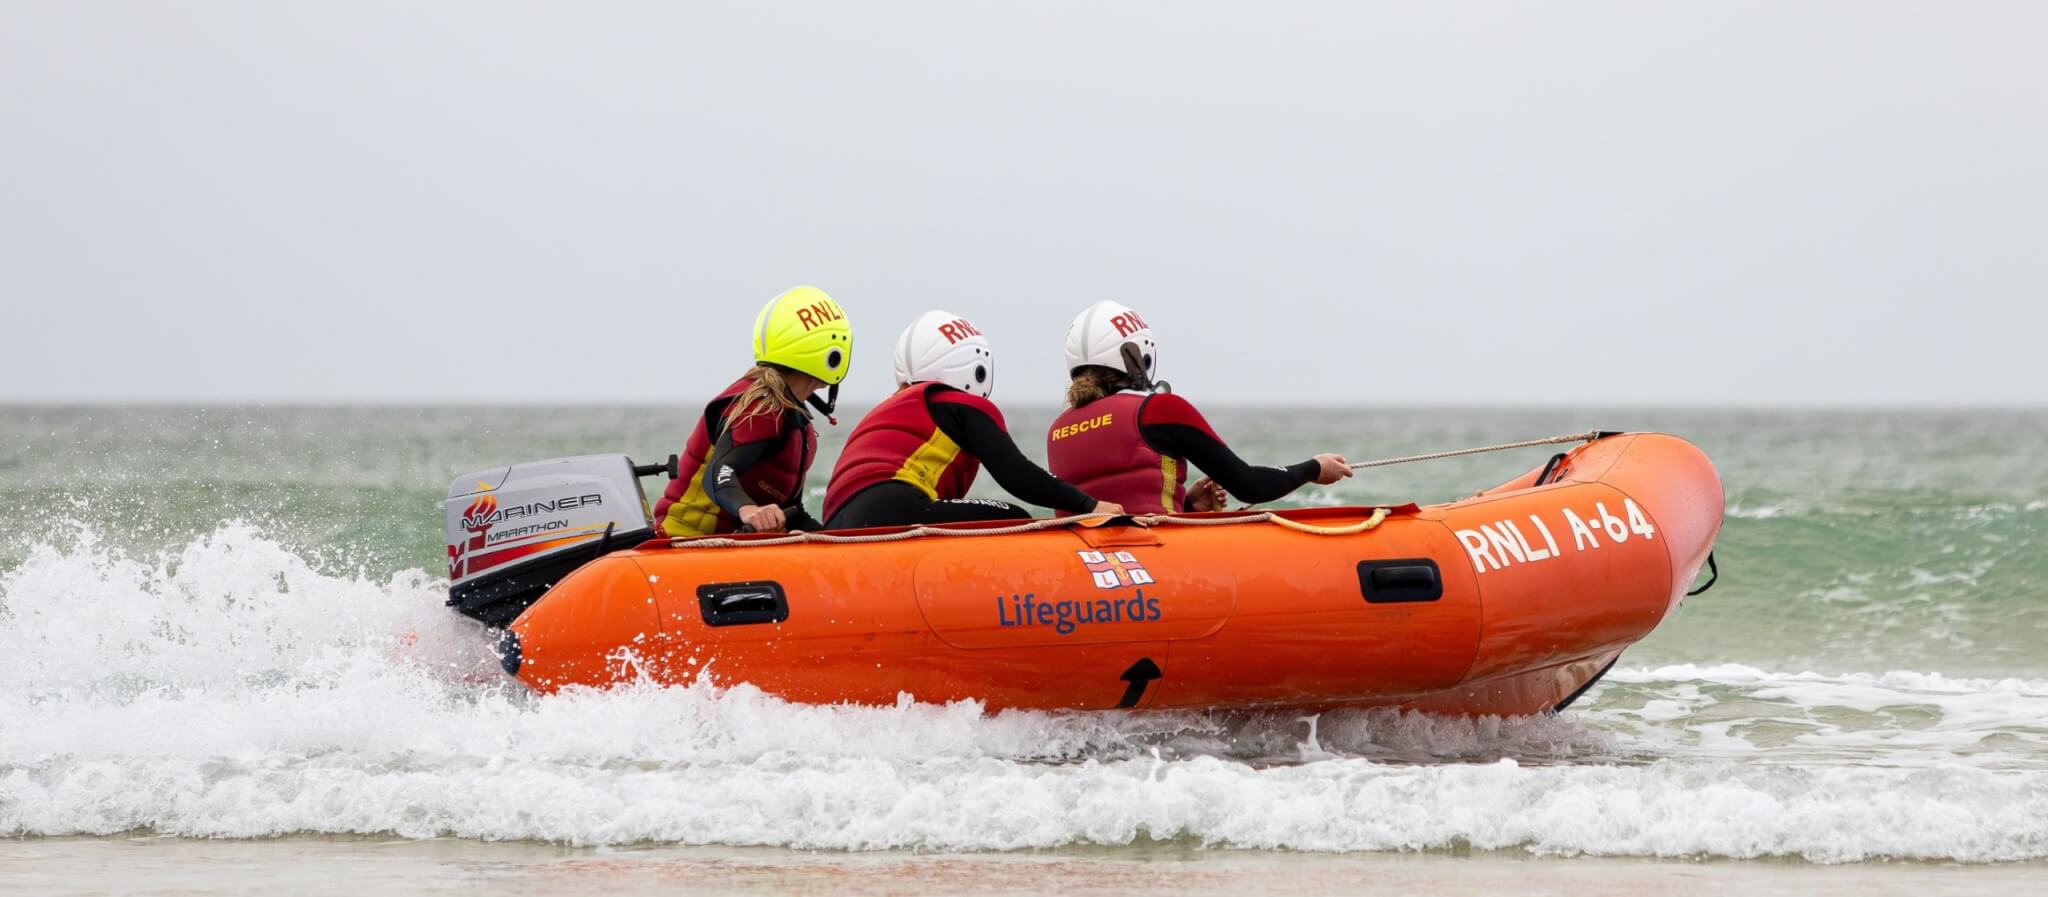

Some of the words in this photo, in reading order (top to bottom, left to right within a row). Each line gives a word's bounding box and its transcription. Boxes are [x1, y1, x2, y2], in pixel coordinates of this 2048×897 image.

[938, 318, 983, 345] RNL
[1110, 310, 1149, 338] RNL
[1052, 413, 1112, 441] RESCUE
[460, 493, 602, 531] MARINER
[487, 519, 568, 543] MARATHON
[1455, 514, 1560, 574] RNLI
[997, 589, 1161, 635] Lifeguards
